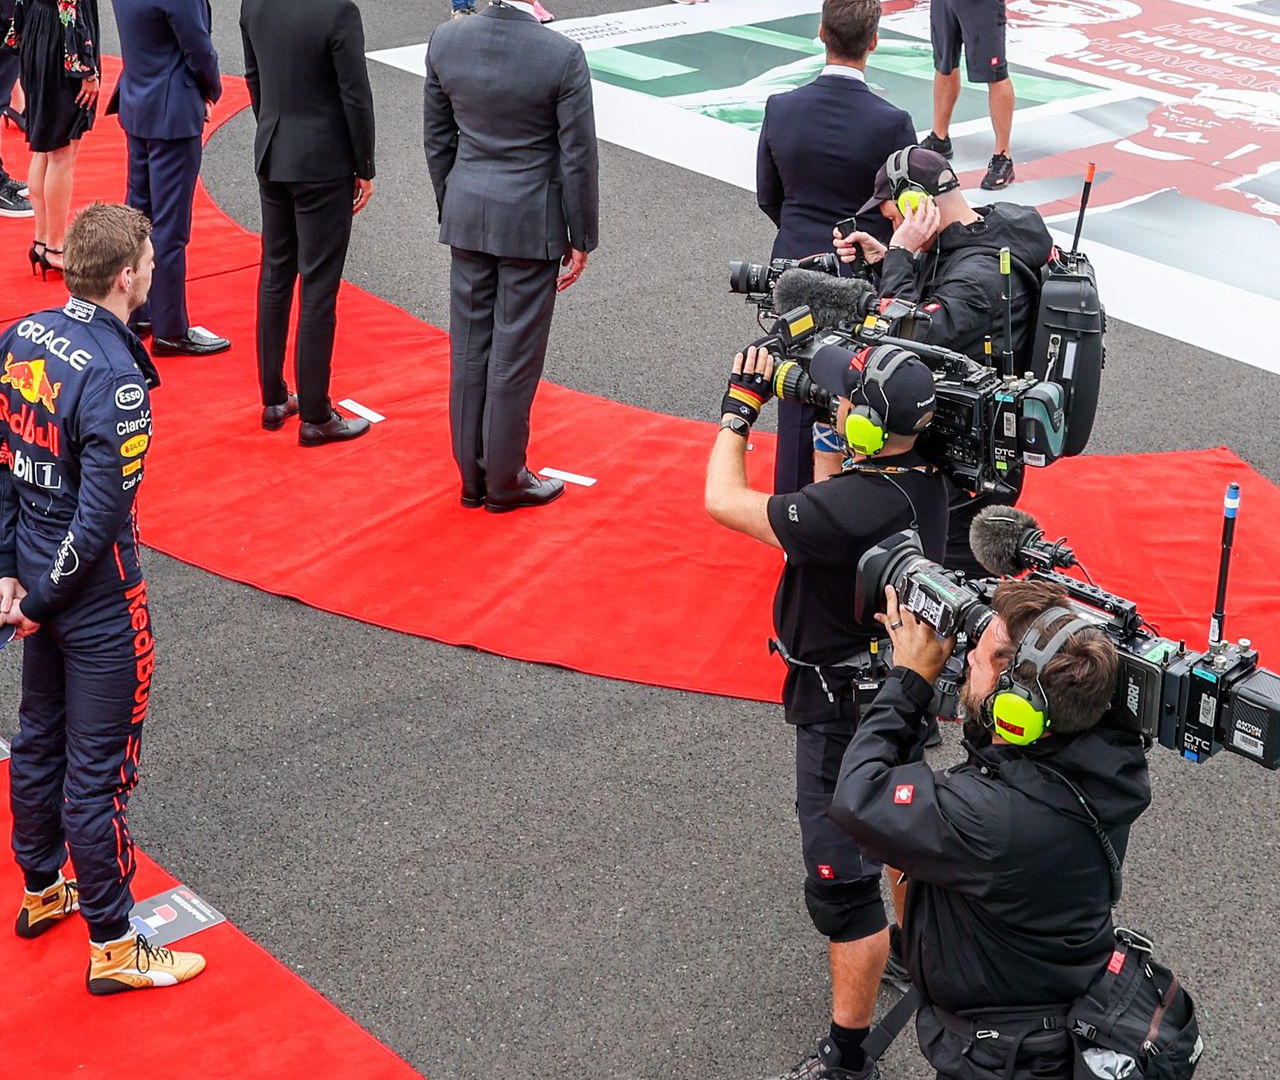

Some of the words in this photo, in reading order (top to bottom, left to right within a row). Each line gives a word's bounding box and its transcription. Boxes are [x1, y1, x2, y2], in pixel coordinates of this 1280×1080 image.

[17, 319, 93, 371] ORACLE
[119, 391, 141, 403] Esso
[994, 447, 1016, 458] DTC
[1127, 684, 1141, 717] ARRI
[1236, 724, 1262, 738] BAUER
[1237, 719, 1262, 733] ANTON
[1184, 732, 1211, 751] DTC
